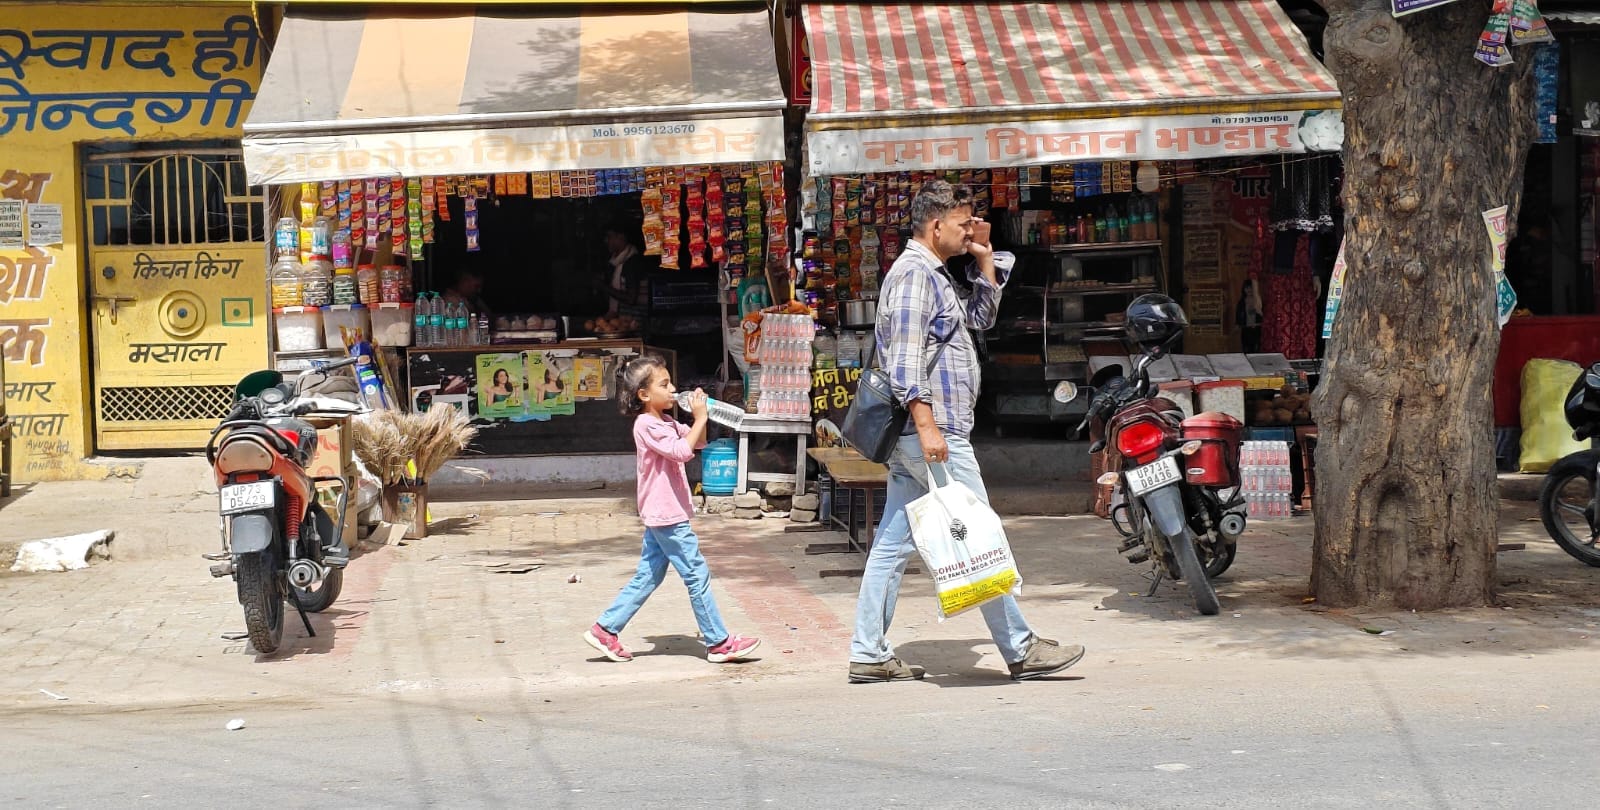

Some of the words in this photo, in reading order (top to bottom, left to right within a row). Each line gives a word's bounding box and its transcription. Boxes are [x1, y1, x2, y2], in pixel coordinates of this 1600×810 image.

[192, 15, 261, 80] ही
[592, 128, 620, 138] Mob.
[623, 124, 696, 136] 9956123670
[863, 136, 974, 166] नमन
[1155, 124, 1295, 152] भण्डार
[132, 252, 193, 280] किचन
[194, 251, 244, 280] किंग
[128, 343, 228, 363] मसाला
[1136, 460, 1169, 479] UP73A
[1140, 469, 1173, 488] D8436
[232, 484, 262, 497] UP73
[969, 548, 1004, 565] SHOPPE
[971, 562, 989, 572] MEGA
